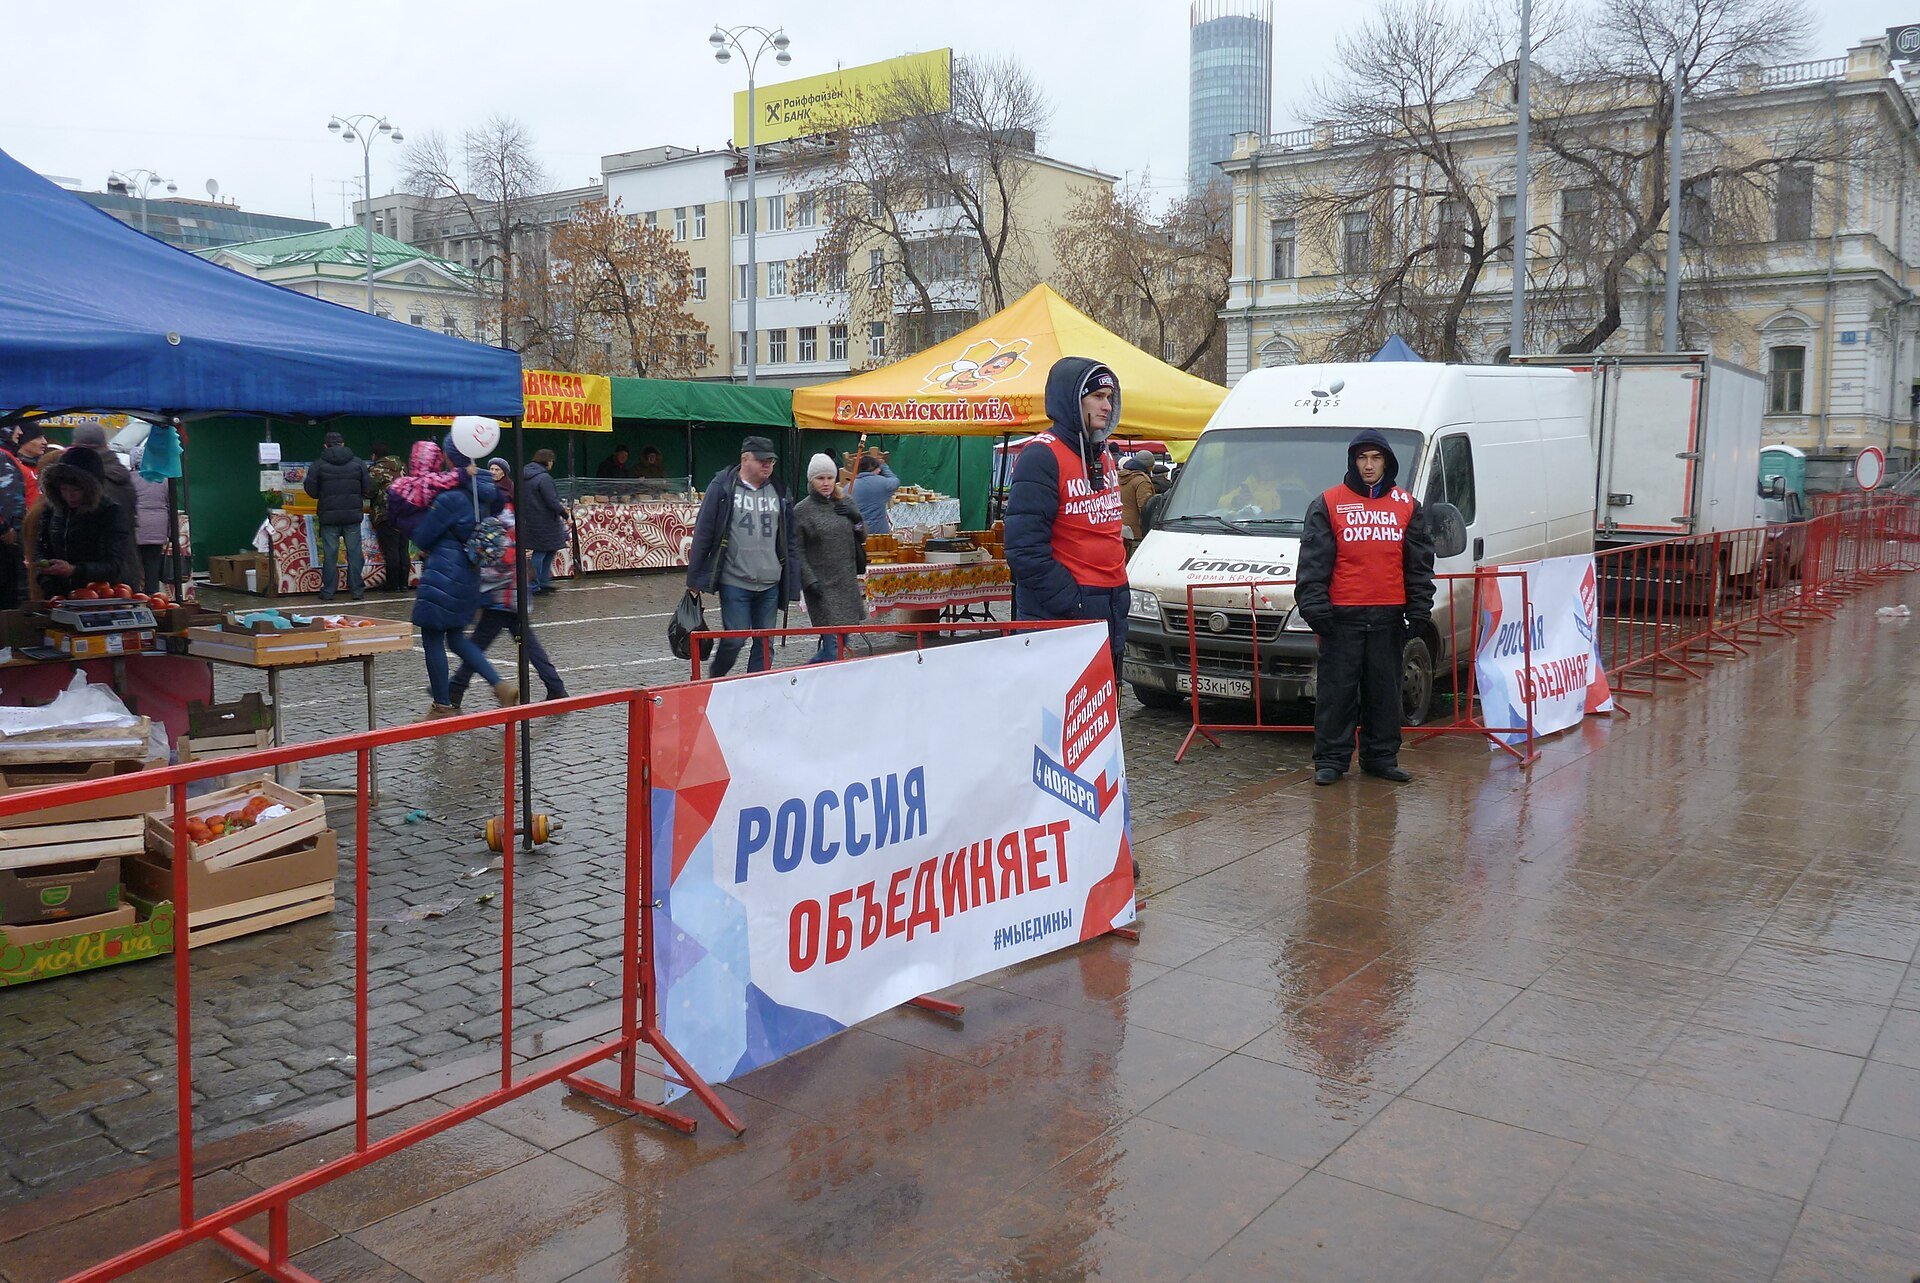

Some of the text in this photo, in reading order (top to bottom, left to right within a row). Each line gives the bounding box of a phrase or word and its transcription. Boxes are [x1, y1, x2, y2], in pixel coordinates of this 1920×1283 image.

[784, 108, 811, 122] БАНК
[526, 399, 603, 427] АБХАЗИИ
[856, 399, 1014, 422] АЛТАЙСКИЙ МЁД
[1294, 399, 1341, 407] CROSS
[733, 493, 780, 512] ROCK
[738, 512, 773, 538] 48
[1346, 511, 1398, 526] СЛУЖБА
[1343, 526, 1403, 542] ОХРАНЫ
[1178, 557, 1291, 577] lenovo
[1186, 573, 1225, 582] Фирма
[1229, 681, 1250, 692] 196
[1066, 679, 1113, 742] НАРОДНОГО
[1067, 685, 1087, 720] ДЕНЬ
[1067, 710, 1110, 766] ЕДИНСТВА
[1036, 758, 1096, 815] 4 НОЯБРЯ
[734, 765, 928, 884] РОССИЯ
[788, 819, 1072, 974] ОБЪЕДИНЯЕТ
[993, 907, 1073, 951] #МЫЕДИНЫ
